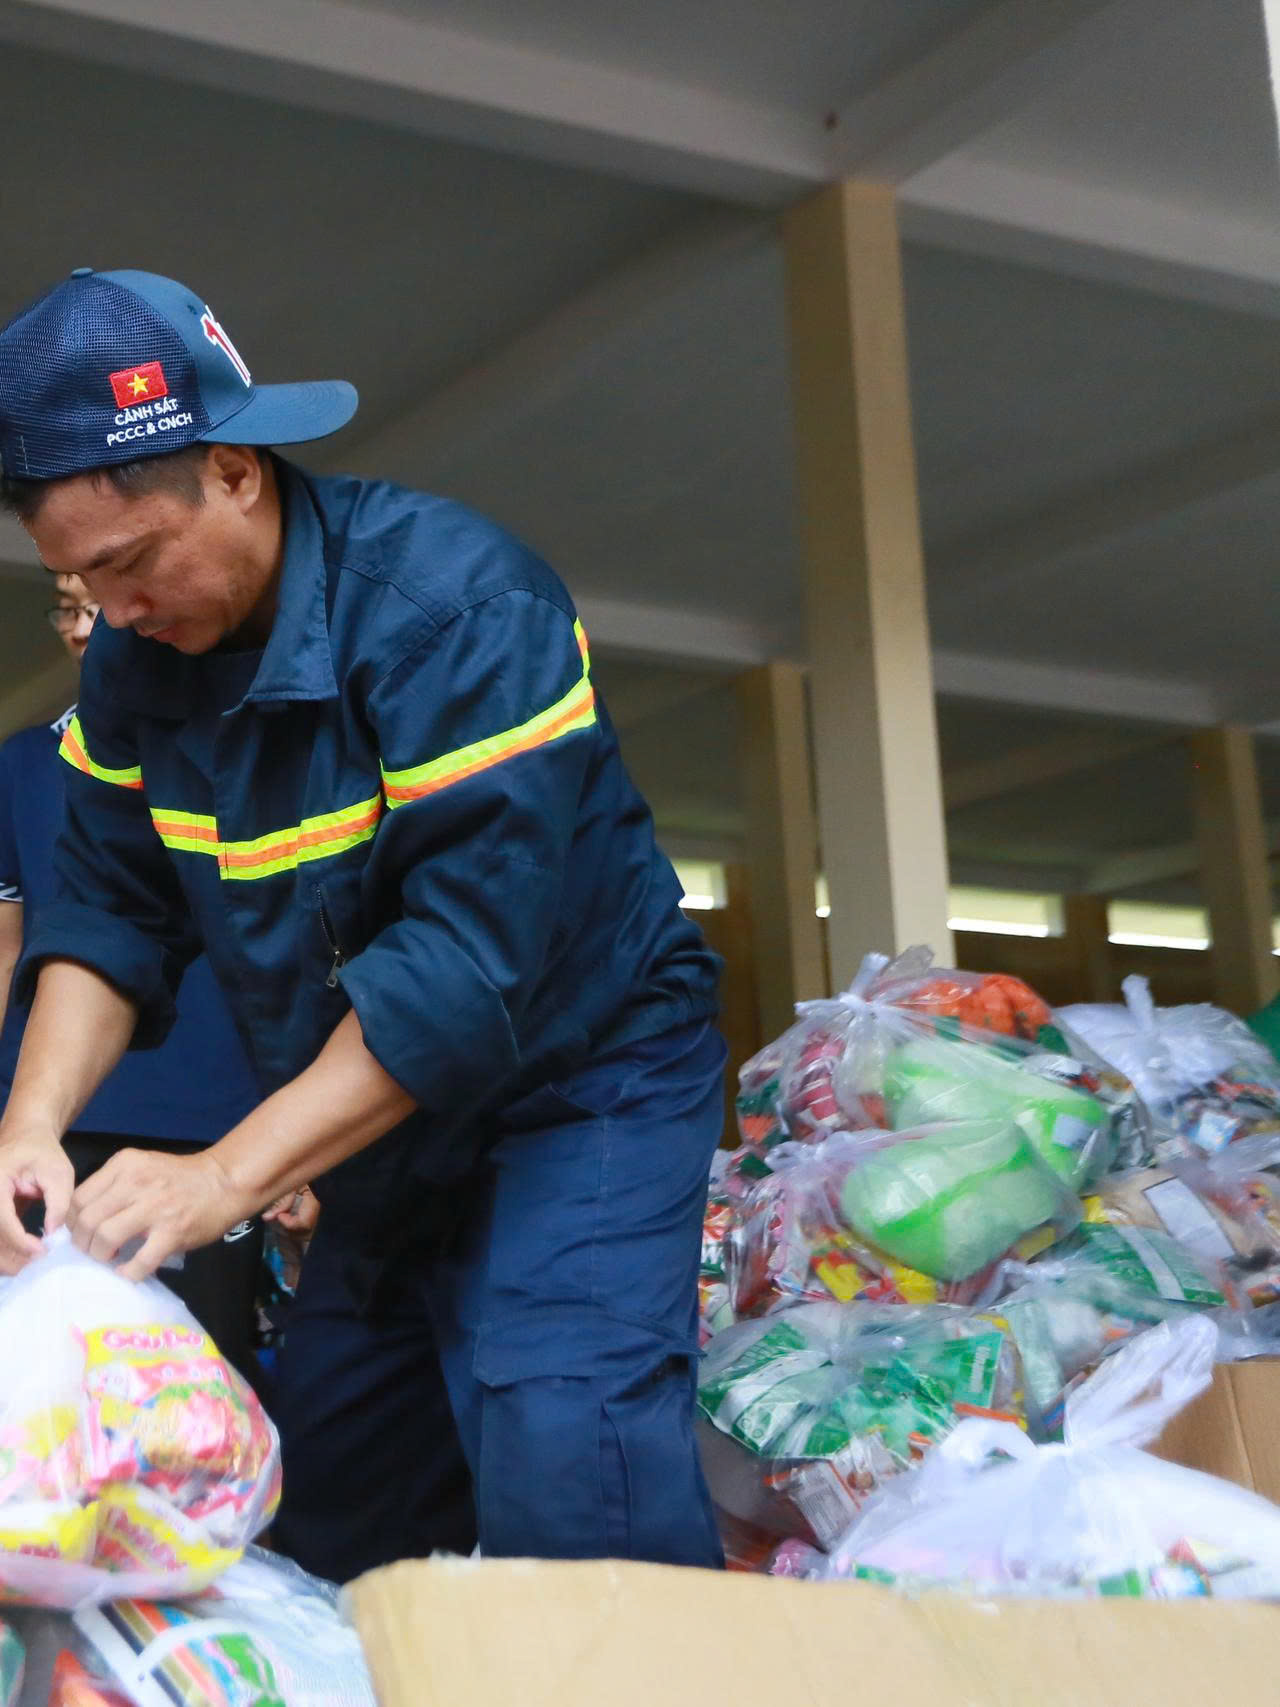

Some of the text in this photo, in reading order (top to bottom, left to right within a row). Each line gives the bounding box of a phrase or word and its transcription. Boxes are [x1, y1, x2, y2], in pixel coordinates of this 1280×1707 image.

[114, 396, 179, 427] CẢNH SÁT
[106, 412, 193, 447] PCCC & CNCH
